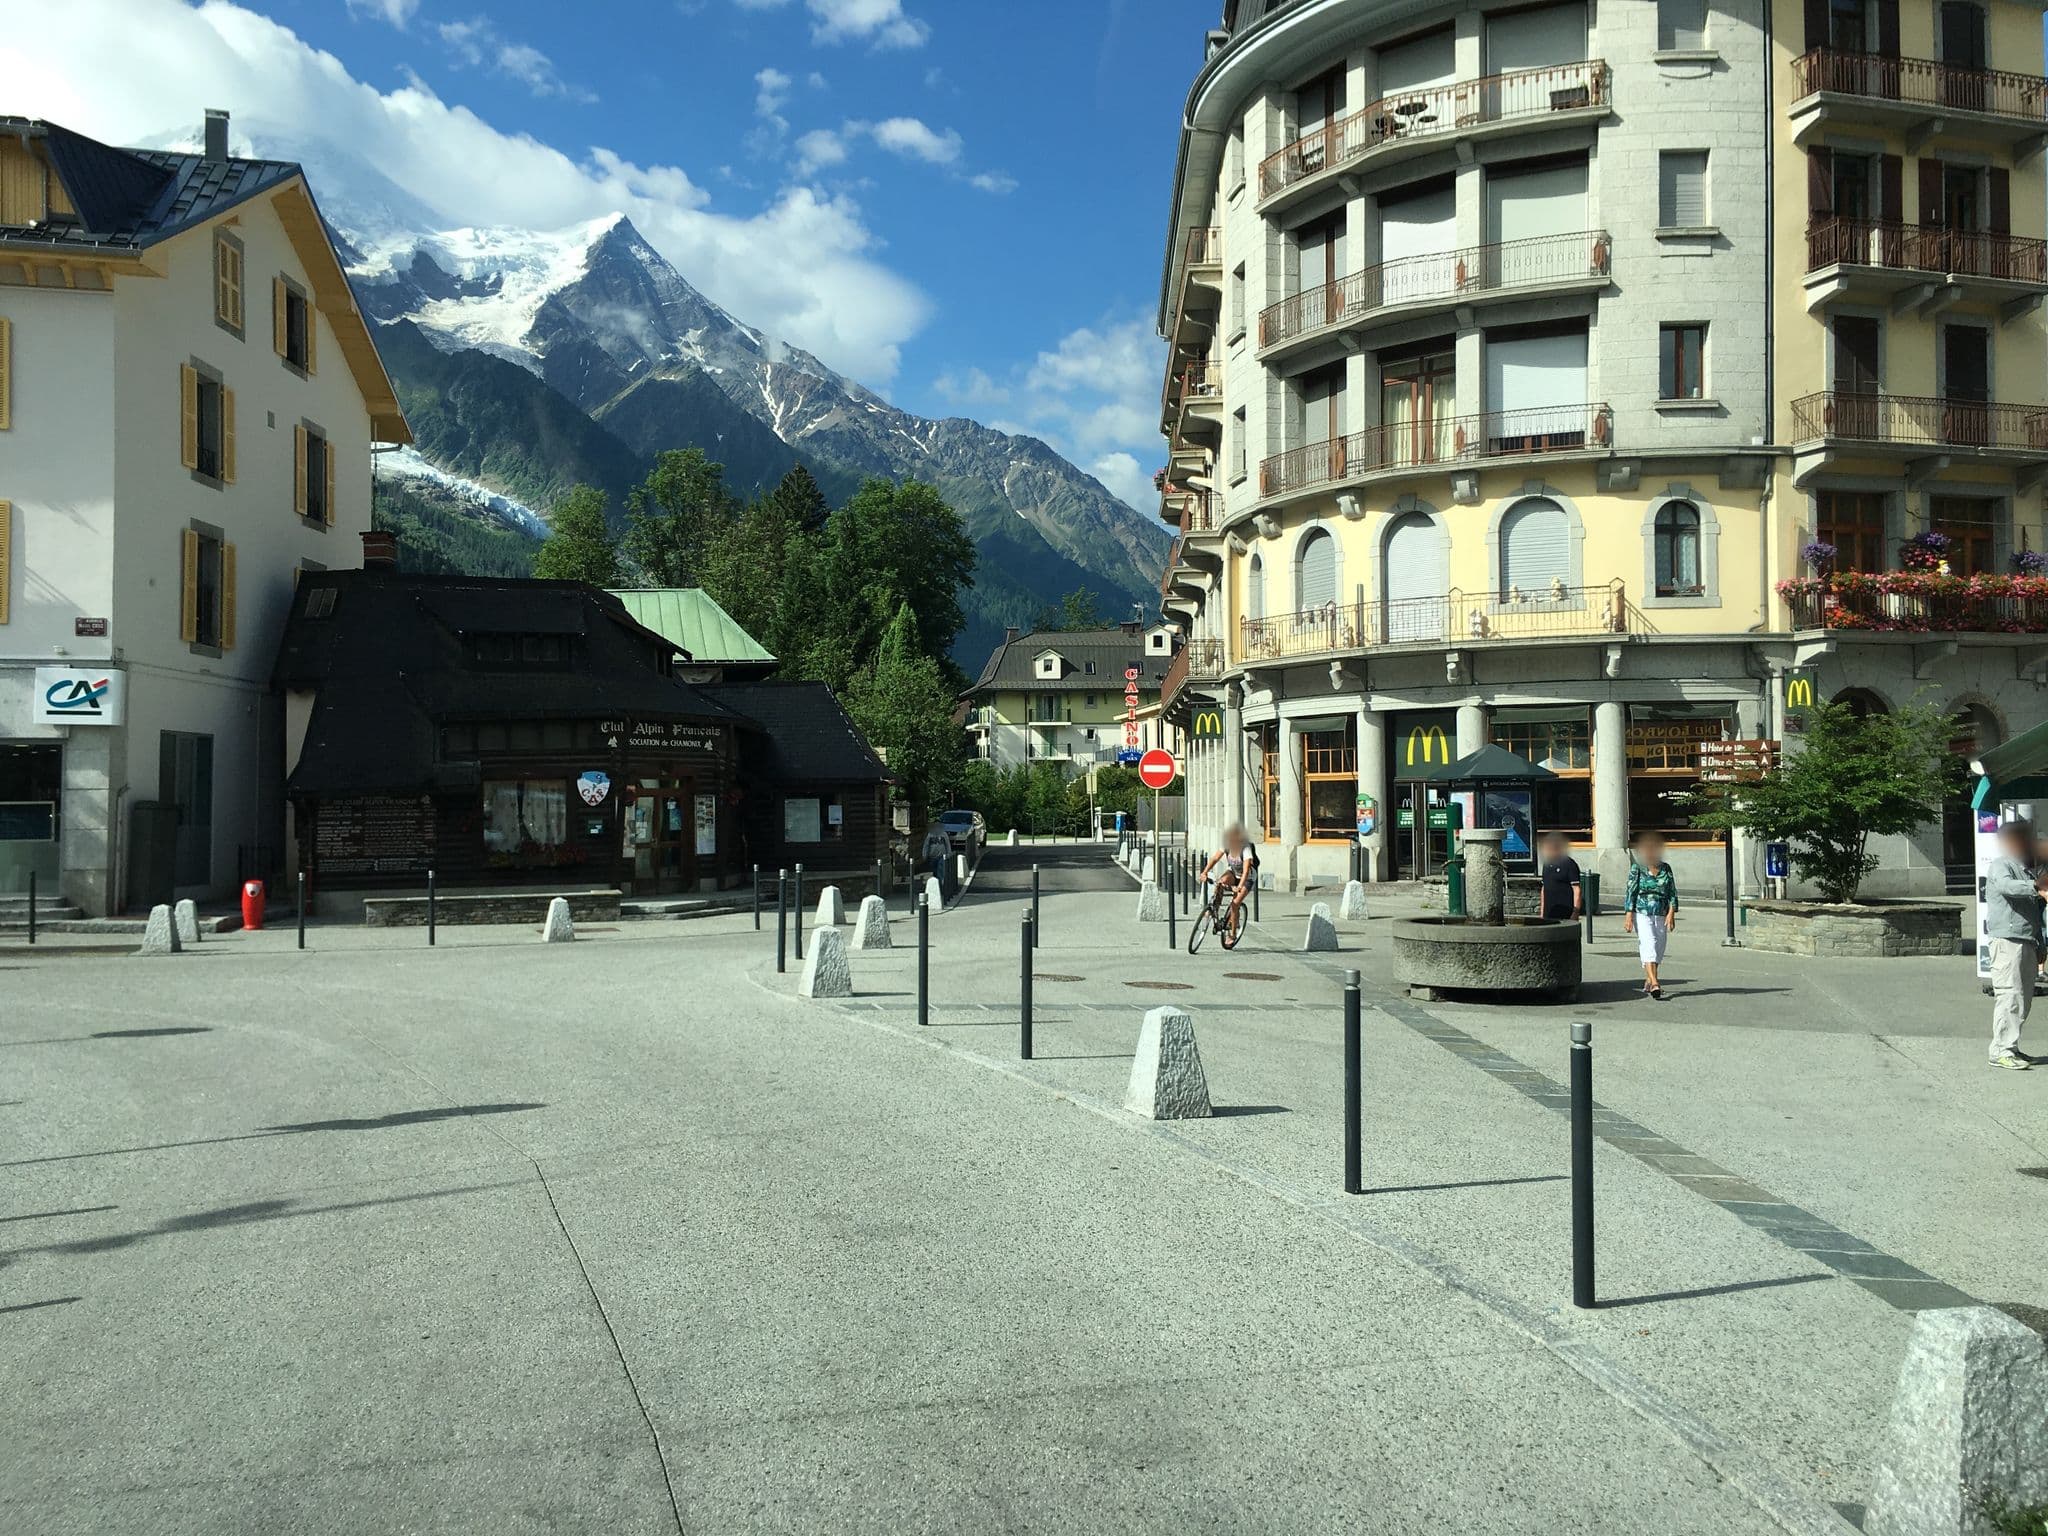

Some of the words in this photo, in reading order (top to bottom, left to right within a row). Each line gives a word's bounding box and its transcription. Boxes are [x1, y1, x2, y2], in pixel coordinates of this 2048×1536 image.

[1124, 668, 1139, 747] CASINO
[632, 722, 664, 736] Alpin
[670, 739, 702, 748] CHAMONIX
